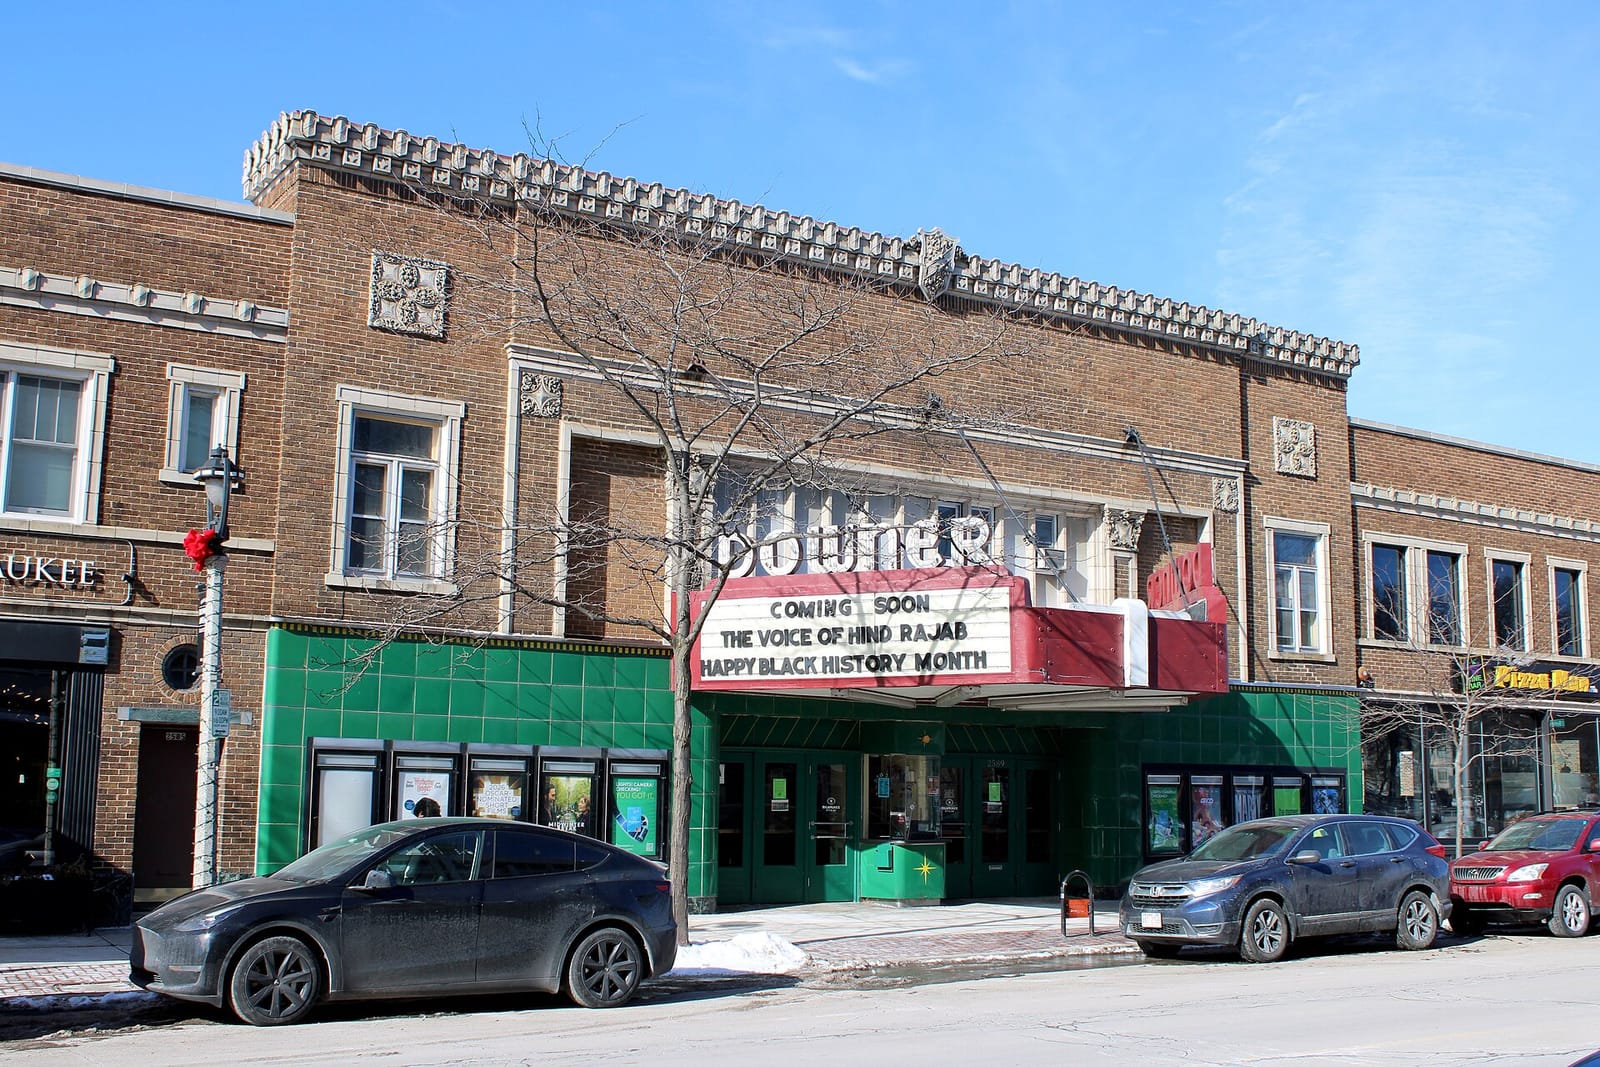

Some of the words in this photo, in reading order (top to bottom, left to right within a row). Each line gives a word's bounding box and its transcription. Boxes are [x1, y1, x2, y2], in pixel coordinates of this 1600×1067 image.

[771, 599, 852, 619] COMING
[874, 594, 929, 614] SOON
[720, 630, 752, 648] THE
[758, 628, 811, 647] VOICE
[818, 627, 842, 644] OF
[848, 624, 892, 643] HIND
[900, 621, 967, 642] RAJAB
[701, 657, 757, 677] HAPPY
[759, 656, 817, 676] BLACK
[822, 652, 905, 673] HISTORY
[915, 651, 987, 671] MONTH
[213, 695, 219, 706] 2
